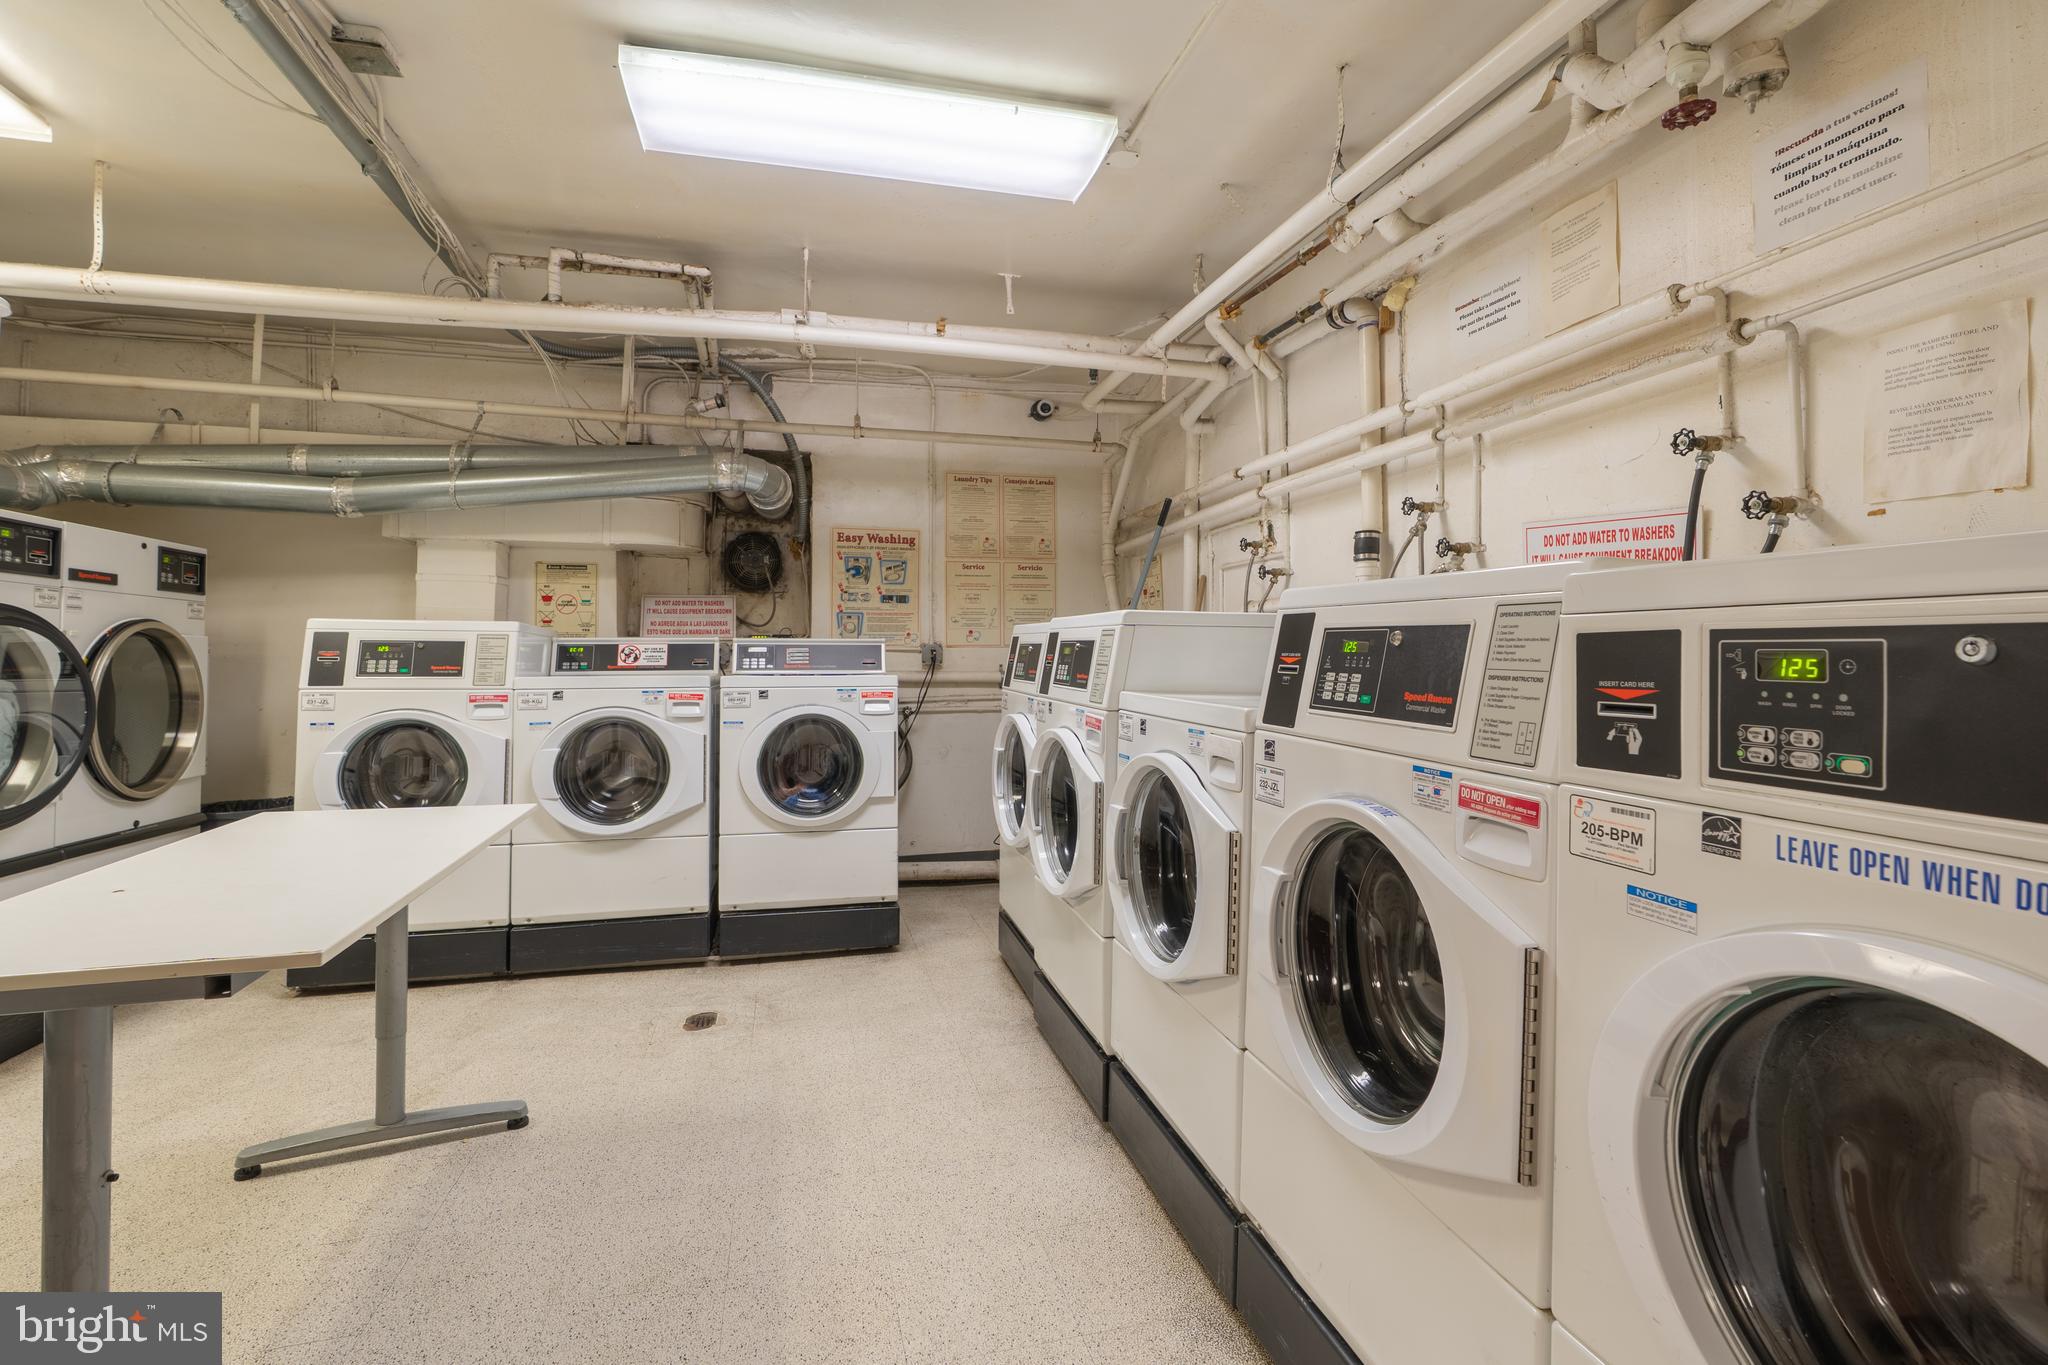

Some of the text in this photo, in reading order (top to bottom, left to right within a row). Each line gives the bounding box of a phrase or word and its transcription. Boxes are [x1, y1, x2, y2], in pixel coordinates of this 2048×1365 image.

[1834, 113, 1850, 126] tus
[1852, 88, 1898, 116] vecinos!
[1770, 103, 1905, 175] Tómese un momento para
[1784, 126, 1888, 182] limpiar la máquina
[1773, 136, 1902, 200] cuando haya terminado.
[1806, 186, 1832, 201] leave
[1833, 176, 1851, 188] the
[1852, 151, 1903, 180] machine
[1778, 172, 1897, 227] clean for the next user.
[1950, 328, 1978, 338] BEFORE
[1981, 324, 2000, 332] AND
[836, 532, 916, 547] Easy Washing
[1543, 524, 1676, 548] DO NOT ADD WATER TO WASHERS
[1634, 546, 1685, 562] BREAKDOW
[1344, 641, 1358, 652] 125
[1780, 658, 1818, 678] 125
[1404, 692, 1452, 704] Speed Queen
[1461, 786, 1470, 798] DO
[1471, 789, 1486, 803] NOT
[1486, 793, 1506, 808] OPEN
[1581, 821, 1644, 847] 205-BPM
[1724, 850, 1742, 859] STAR
[1776, 834, 1839, 872] LEAVE
[1849, 847, 1910, 886] OPEN
[1922, 860, 2001, 906] WHEN
[1636, 888, 1688, 910] NOTICE
